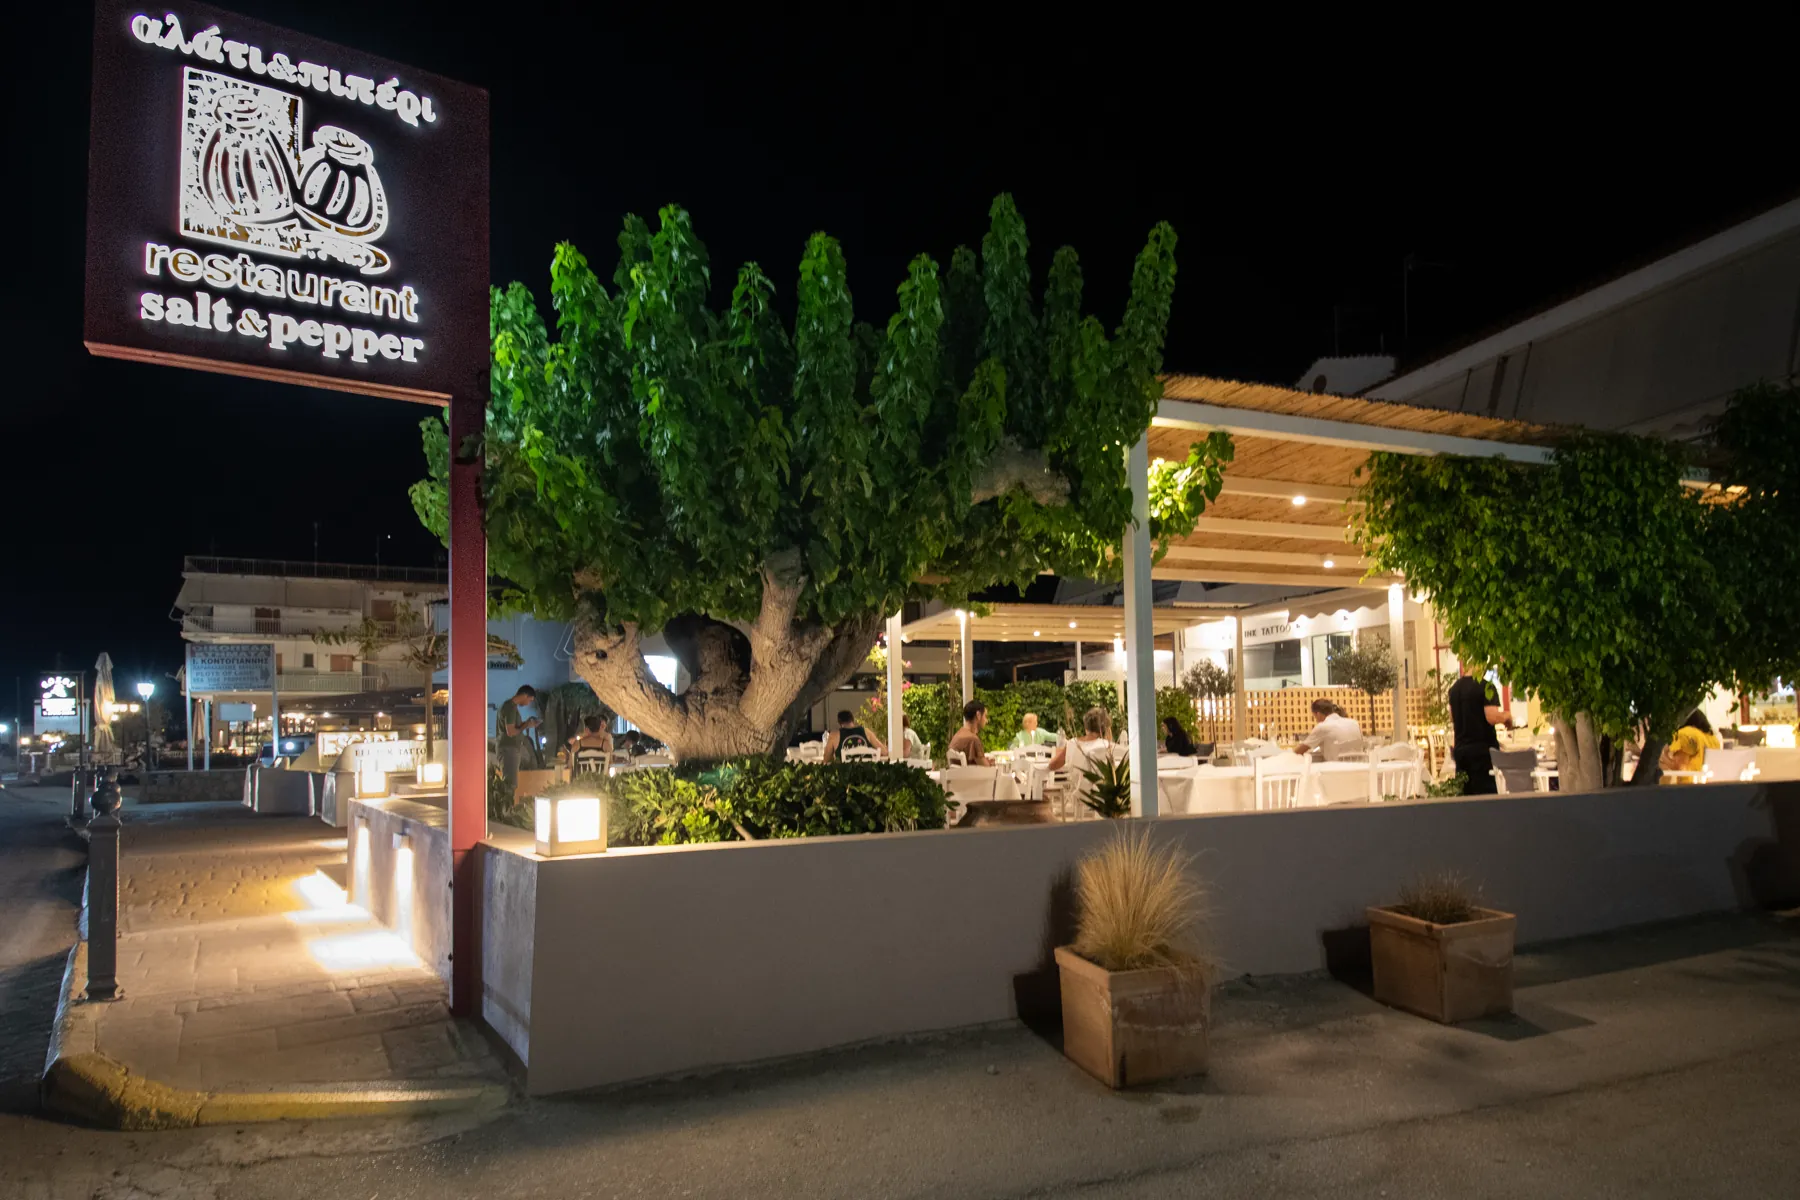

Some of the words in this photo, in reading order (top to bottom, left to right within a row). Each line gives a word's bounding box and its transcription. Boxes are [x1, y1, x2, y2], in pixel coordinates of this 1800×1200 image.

[145, 242, 420, 323] restaurant
[1244, 629, 1257, 638] INK
[1261, 624, 1292, 637] TATTOO
